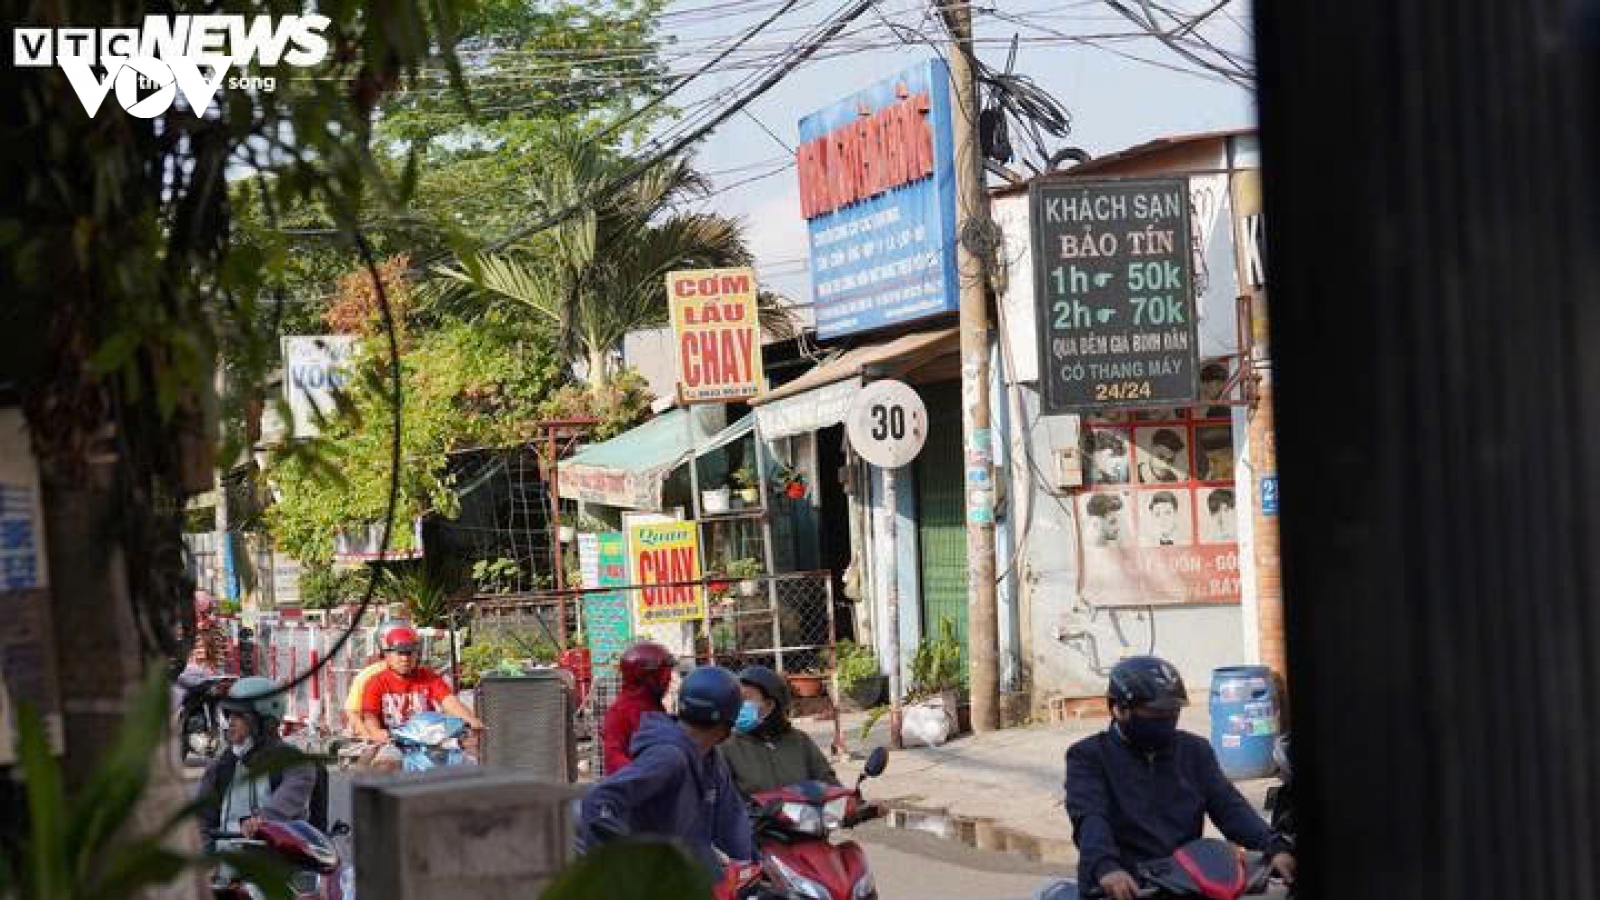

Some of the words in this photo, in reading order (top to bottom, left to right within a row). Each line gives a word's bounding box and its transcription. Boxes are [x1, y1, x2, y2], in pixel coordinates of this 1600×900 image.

[1046, 190, 1127, 221] KHÁCH
[1133, 193, 1180, 223] SẠN
[1060, 225, 1117, 258] BẢO
[1127, 225, 1174, 254] TÍN
[675, 274, 749, 296] CƠM
[1052, 264, 1088, 294] 1h
[1128, 261, 1181, 290] 50k
[1053, 300, 1091, 329] 2h
[1129, 295, 1184, 325] 70k
[681, 328, 752, 387] CHAY
[1053, 338, 1078, 359] QUA
[1060, 361, 1085, 381] CÓ
[1090, 361, 1143, 379] THANG
[1149, 357, 1182, 375] MÁY
[1095, 382, 1151, 400] 24/24
[872, 404, 905, 441] 30
[640, 547, 694, 607] CHAY
